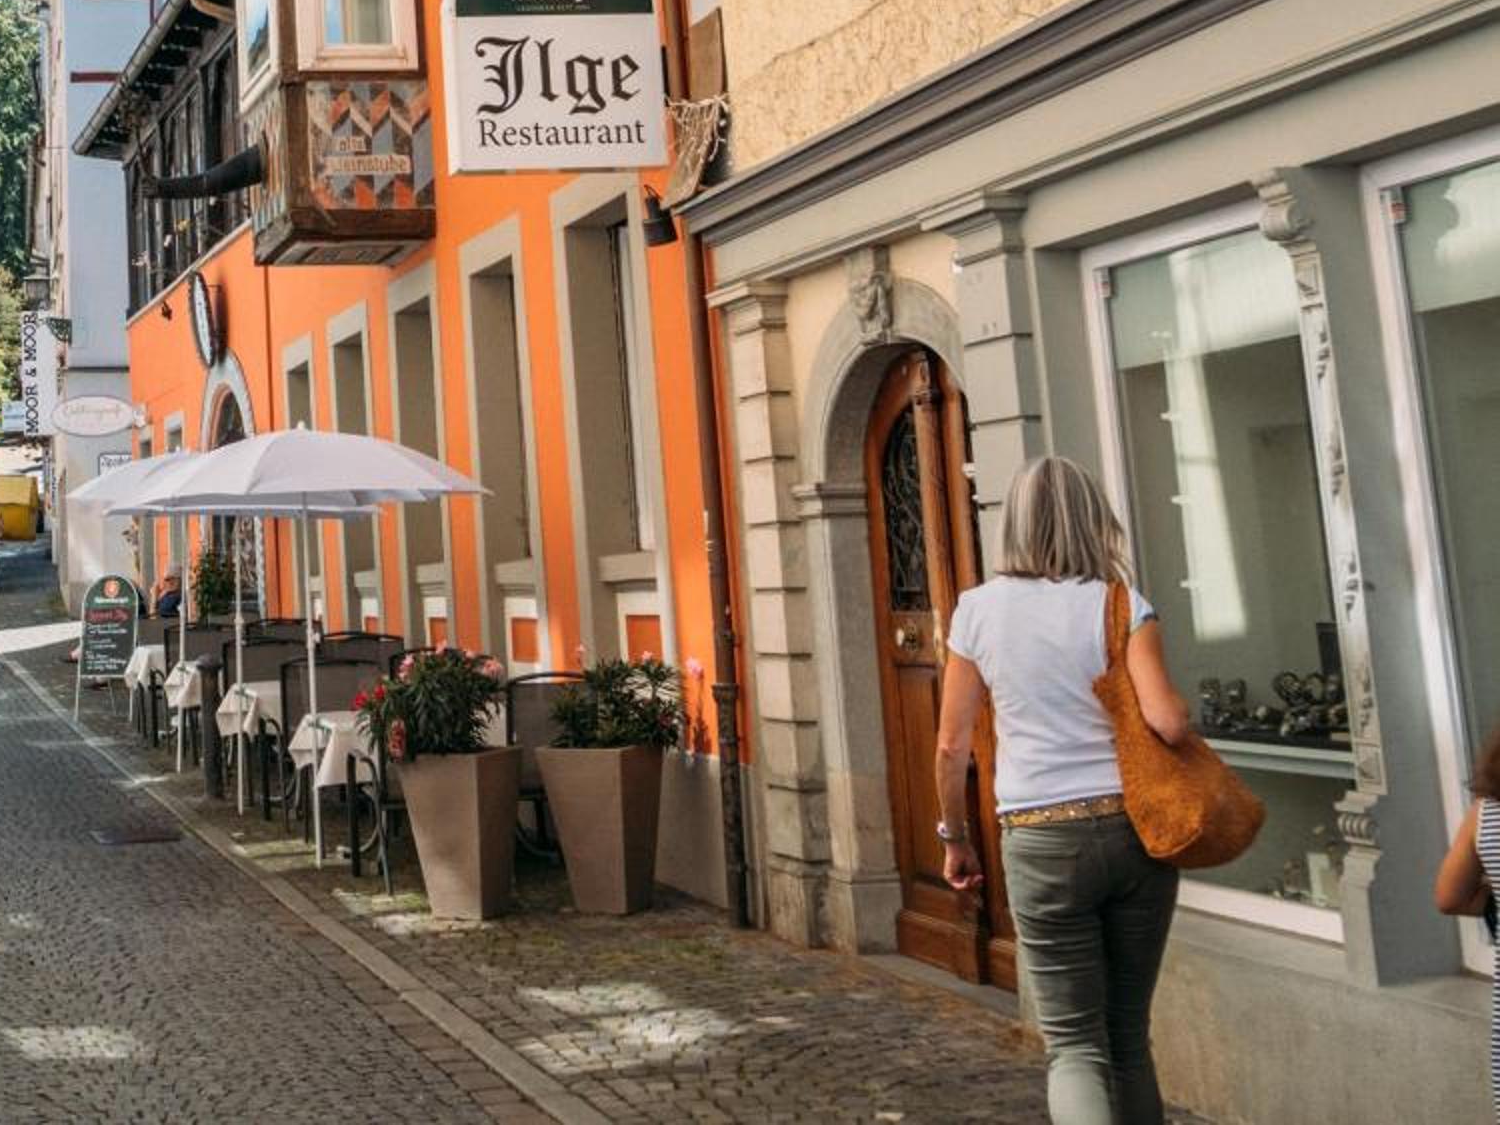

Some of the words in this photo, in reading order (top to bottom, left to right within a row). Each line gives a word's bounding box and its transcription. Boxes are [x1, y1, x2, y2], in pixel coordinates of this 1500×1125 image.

[478, 118, 646, 147] Restaurant
[23, 313, 37, 361] MOOR
[25, 365, 37, 378] &
[25, 383, 39, 433] MOOR
